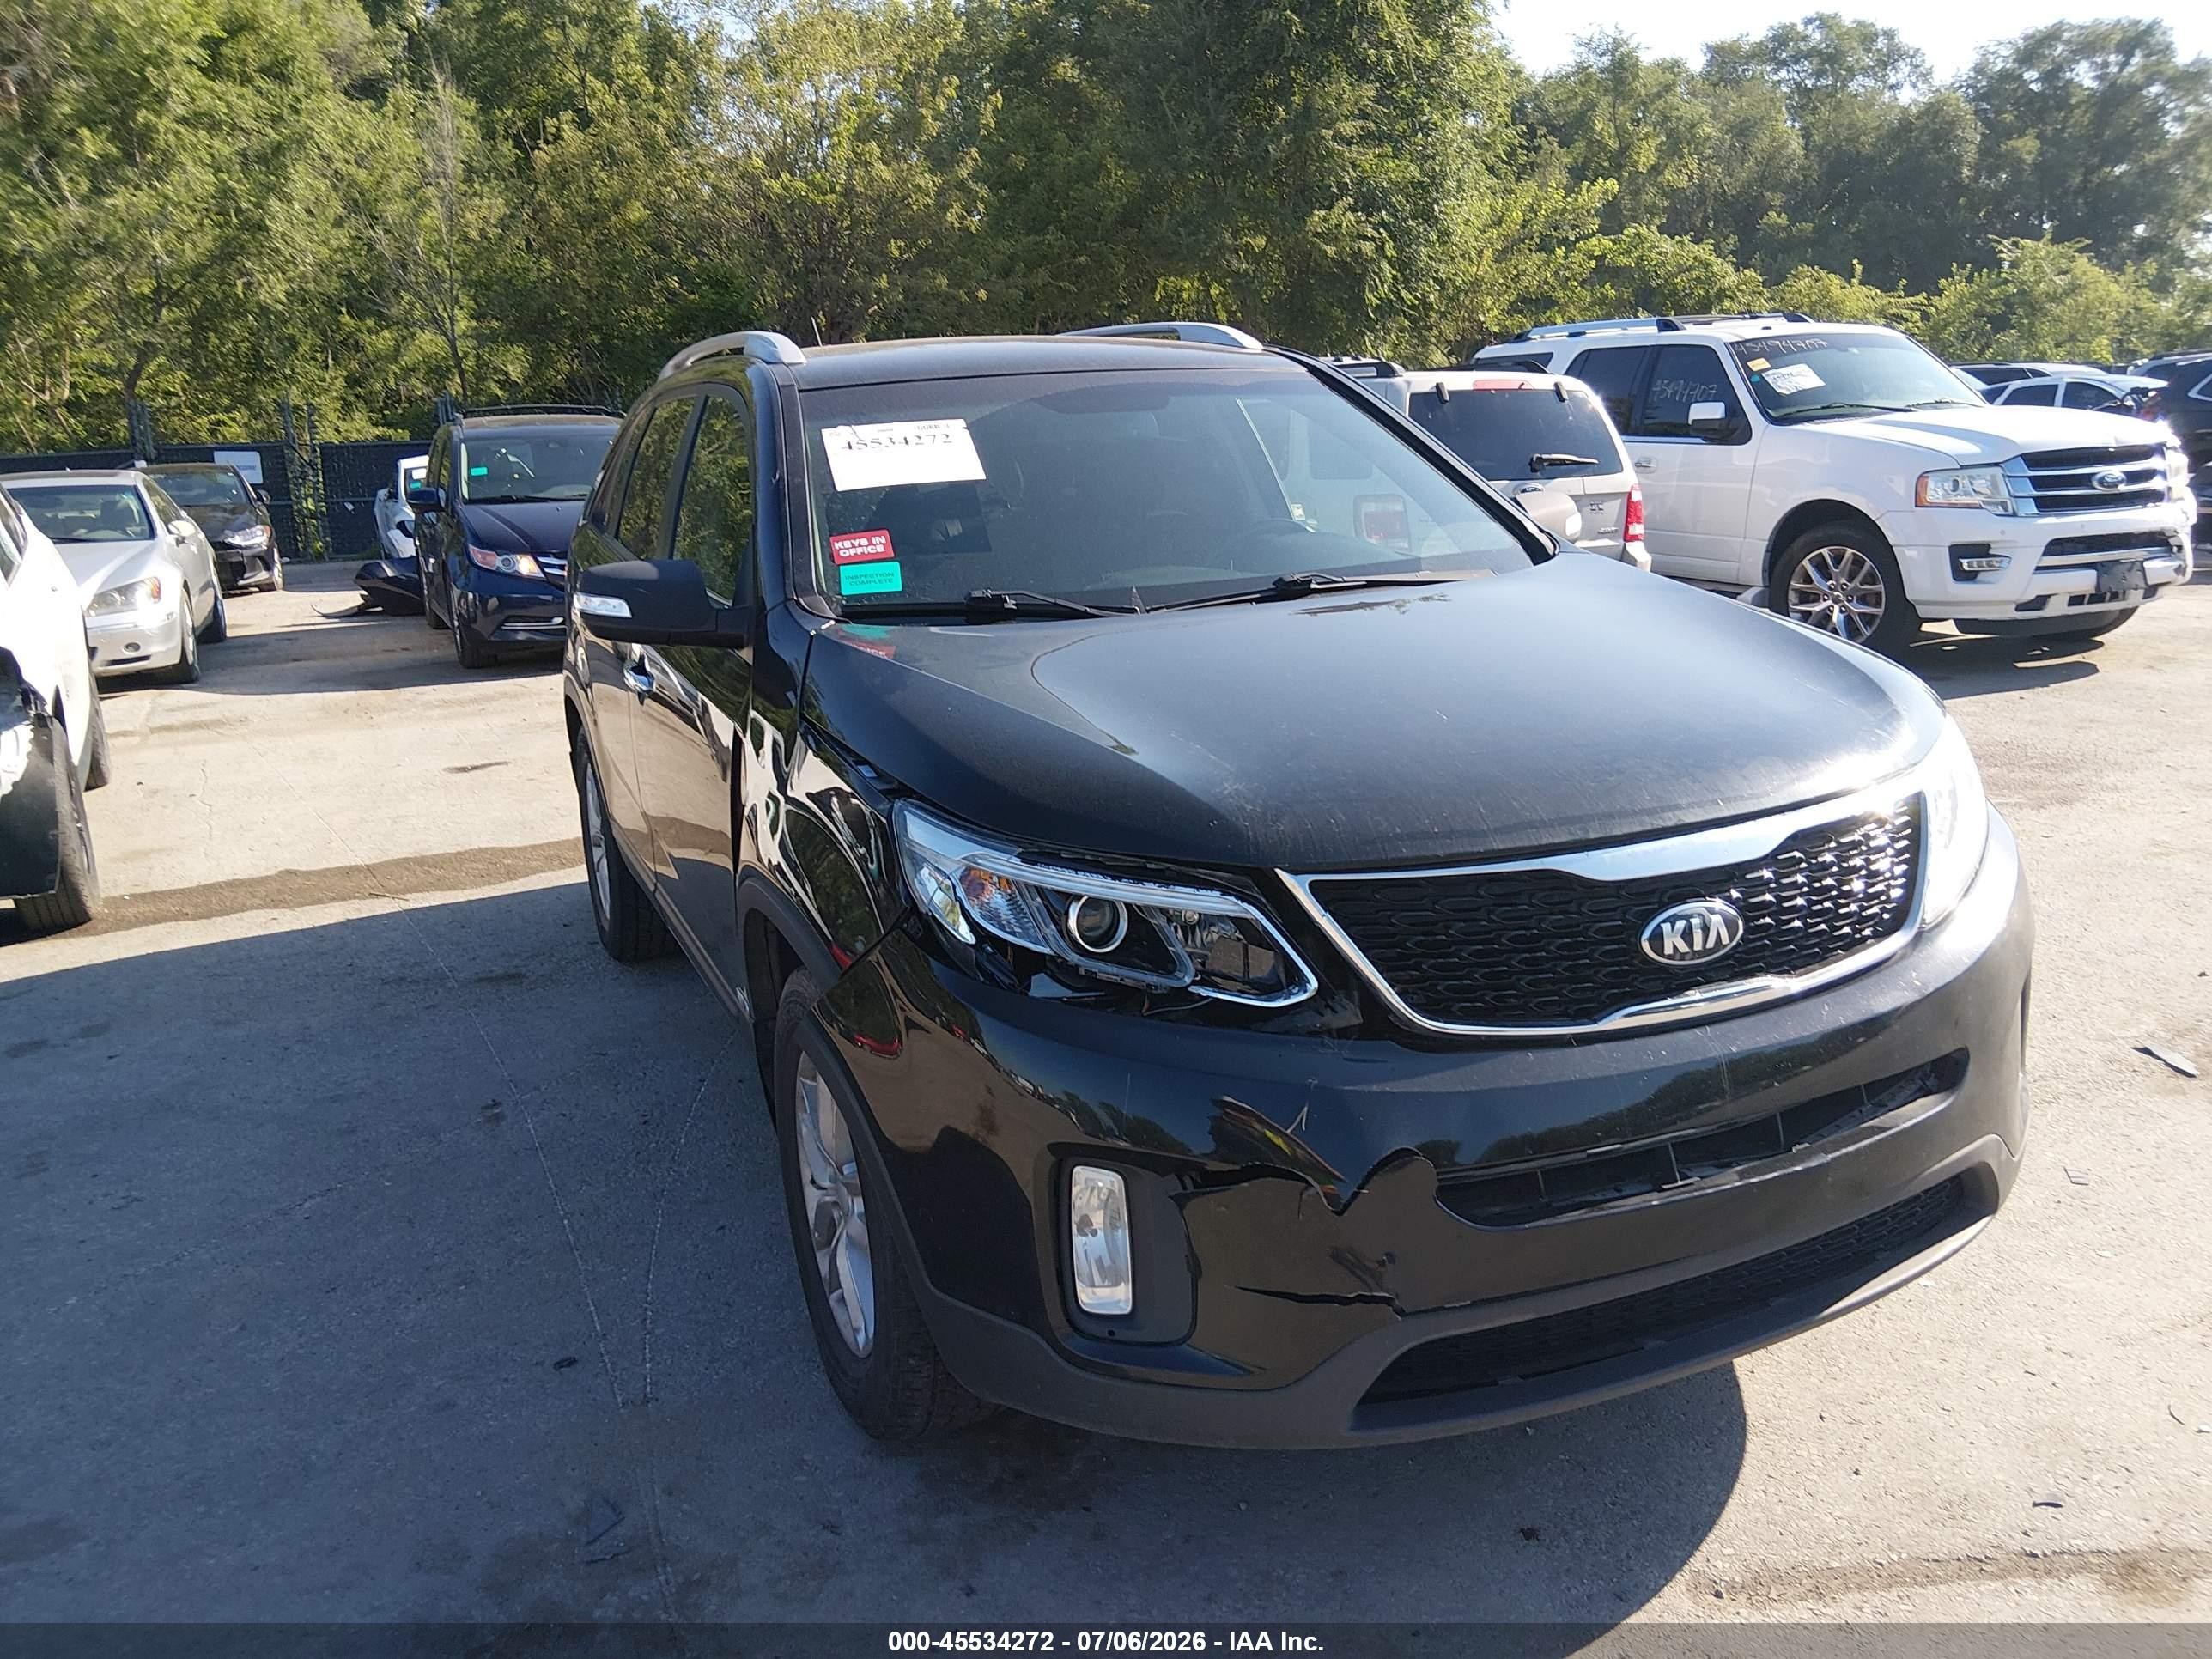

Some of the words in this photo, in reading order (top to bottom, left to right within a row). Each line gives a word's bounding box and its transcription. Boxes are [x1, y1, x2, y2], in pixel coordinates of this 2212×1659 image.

[841, 433, 953, 450] 45534272
[834, 538, 868, 550] KEYS
[872, 535, 886, 544] IN
[839, 544, 886, 557] OFFICE
[845, 572, 894, 580] INSPECTION
[849, 578, 893, 586] COMPLETE
[1660, 914, 1729, 955] KIA
